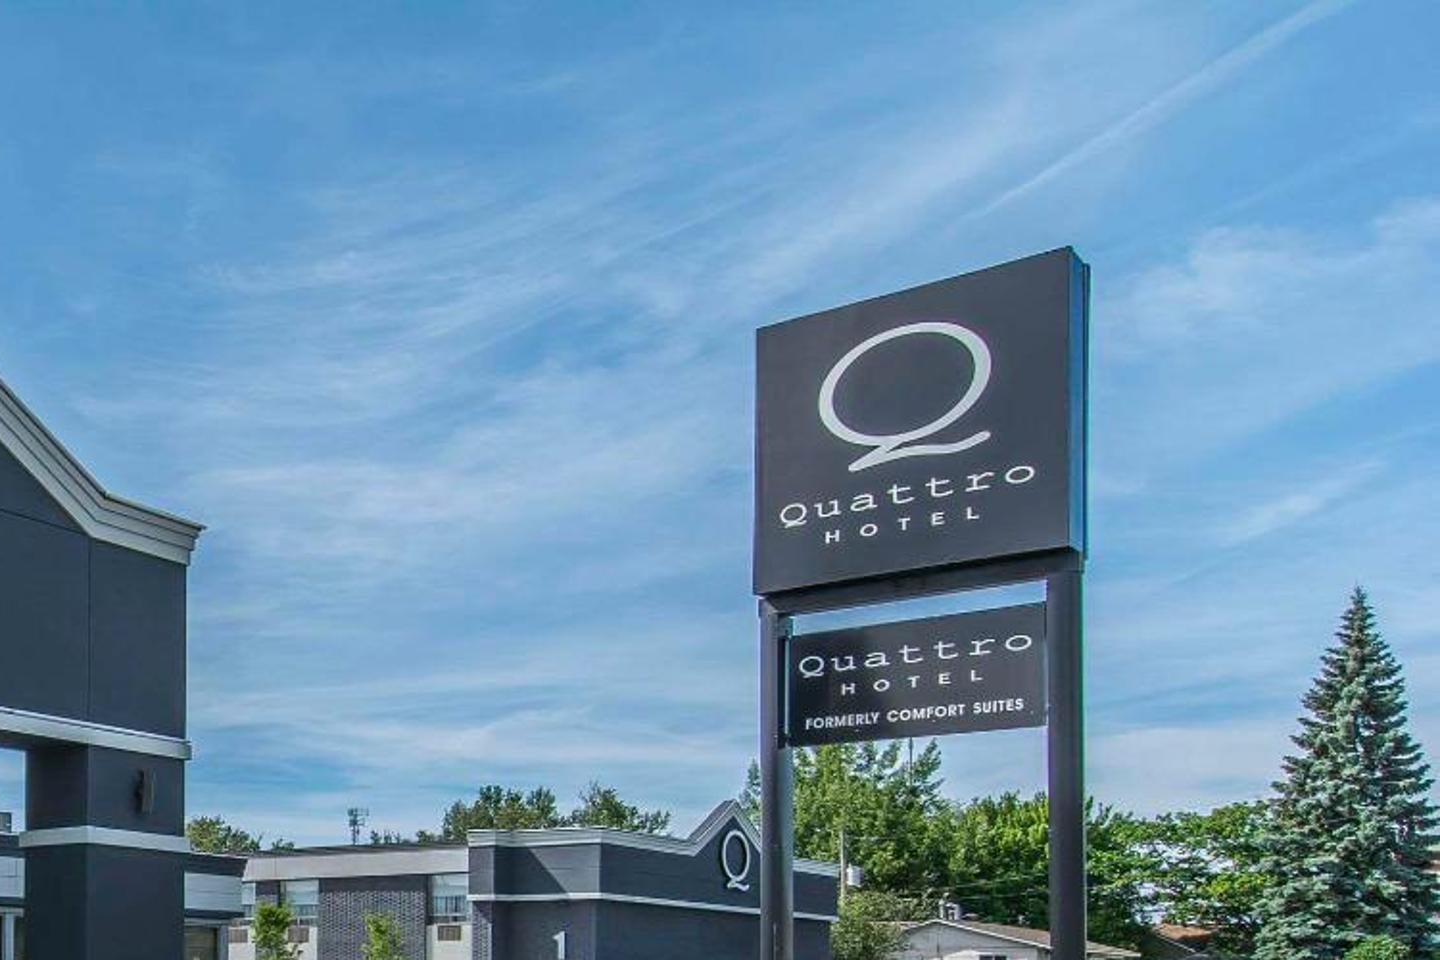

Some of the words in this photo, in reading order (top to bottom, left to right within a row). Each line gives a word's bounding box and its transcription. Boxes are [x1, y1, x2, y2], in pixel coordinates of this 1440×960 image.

[817, 321, 992, 473] Q
[778, 465, 1036, 529] Quattro
[824, 506, 981, 545] HOTEL
[798, 634, 1034, 679] Quattro
[841, 669, 984, 696] HOTEL
[805, 711, 880, 730] FORMERLY
[886, 703, 966, 723] COMFORT
[972, 697, 1025, 715] SUITES
[722, 829, 751, 891] Q
[552, 930, 566, 960] 1
